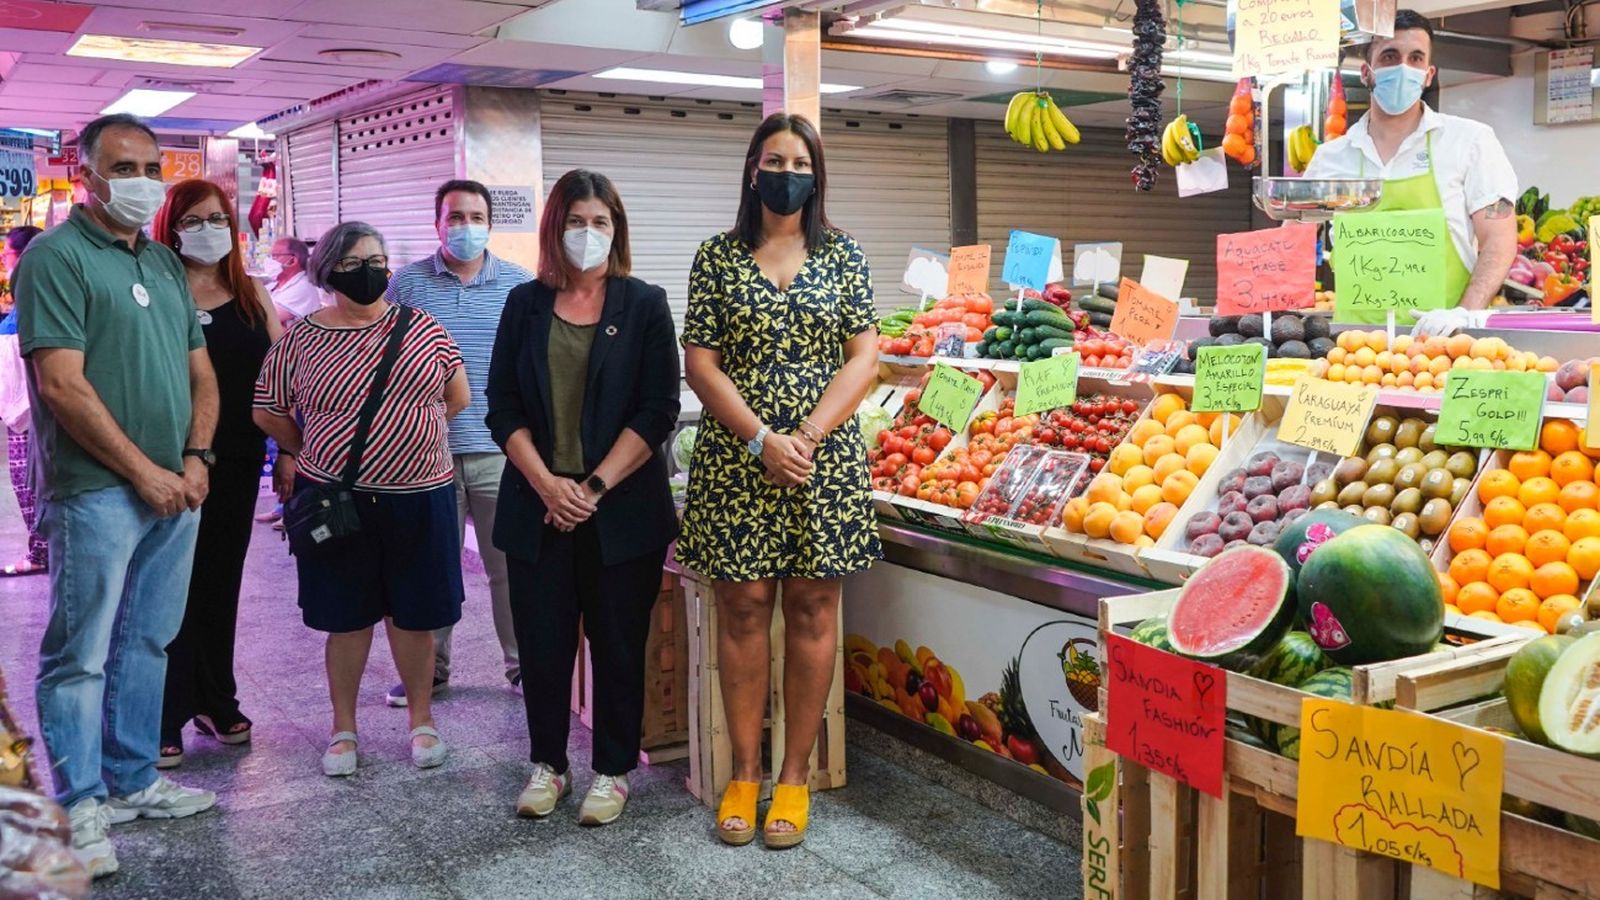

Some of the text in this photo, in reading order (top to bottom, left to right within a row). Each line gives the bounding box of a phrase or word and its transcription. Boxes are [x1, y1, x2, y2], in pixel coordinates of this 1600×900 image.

[1260, 12, 1277, 25] 20
[1280, 10, 1314, 21] euros
[1266, 51, 1300, 66] Tomate
[173, 161, 200, 177] 29
[1339, 221, 1435, 239] ALBARICOQUES
[1205, 368, 1255, 380] AMARILLO
[1311, 708, 1434, 782] SANDÍA
[1361, 775, 1483, 837] RALLADA
